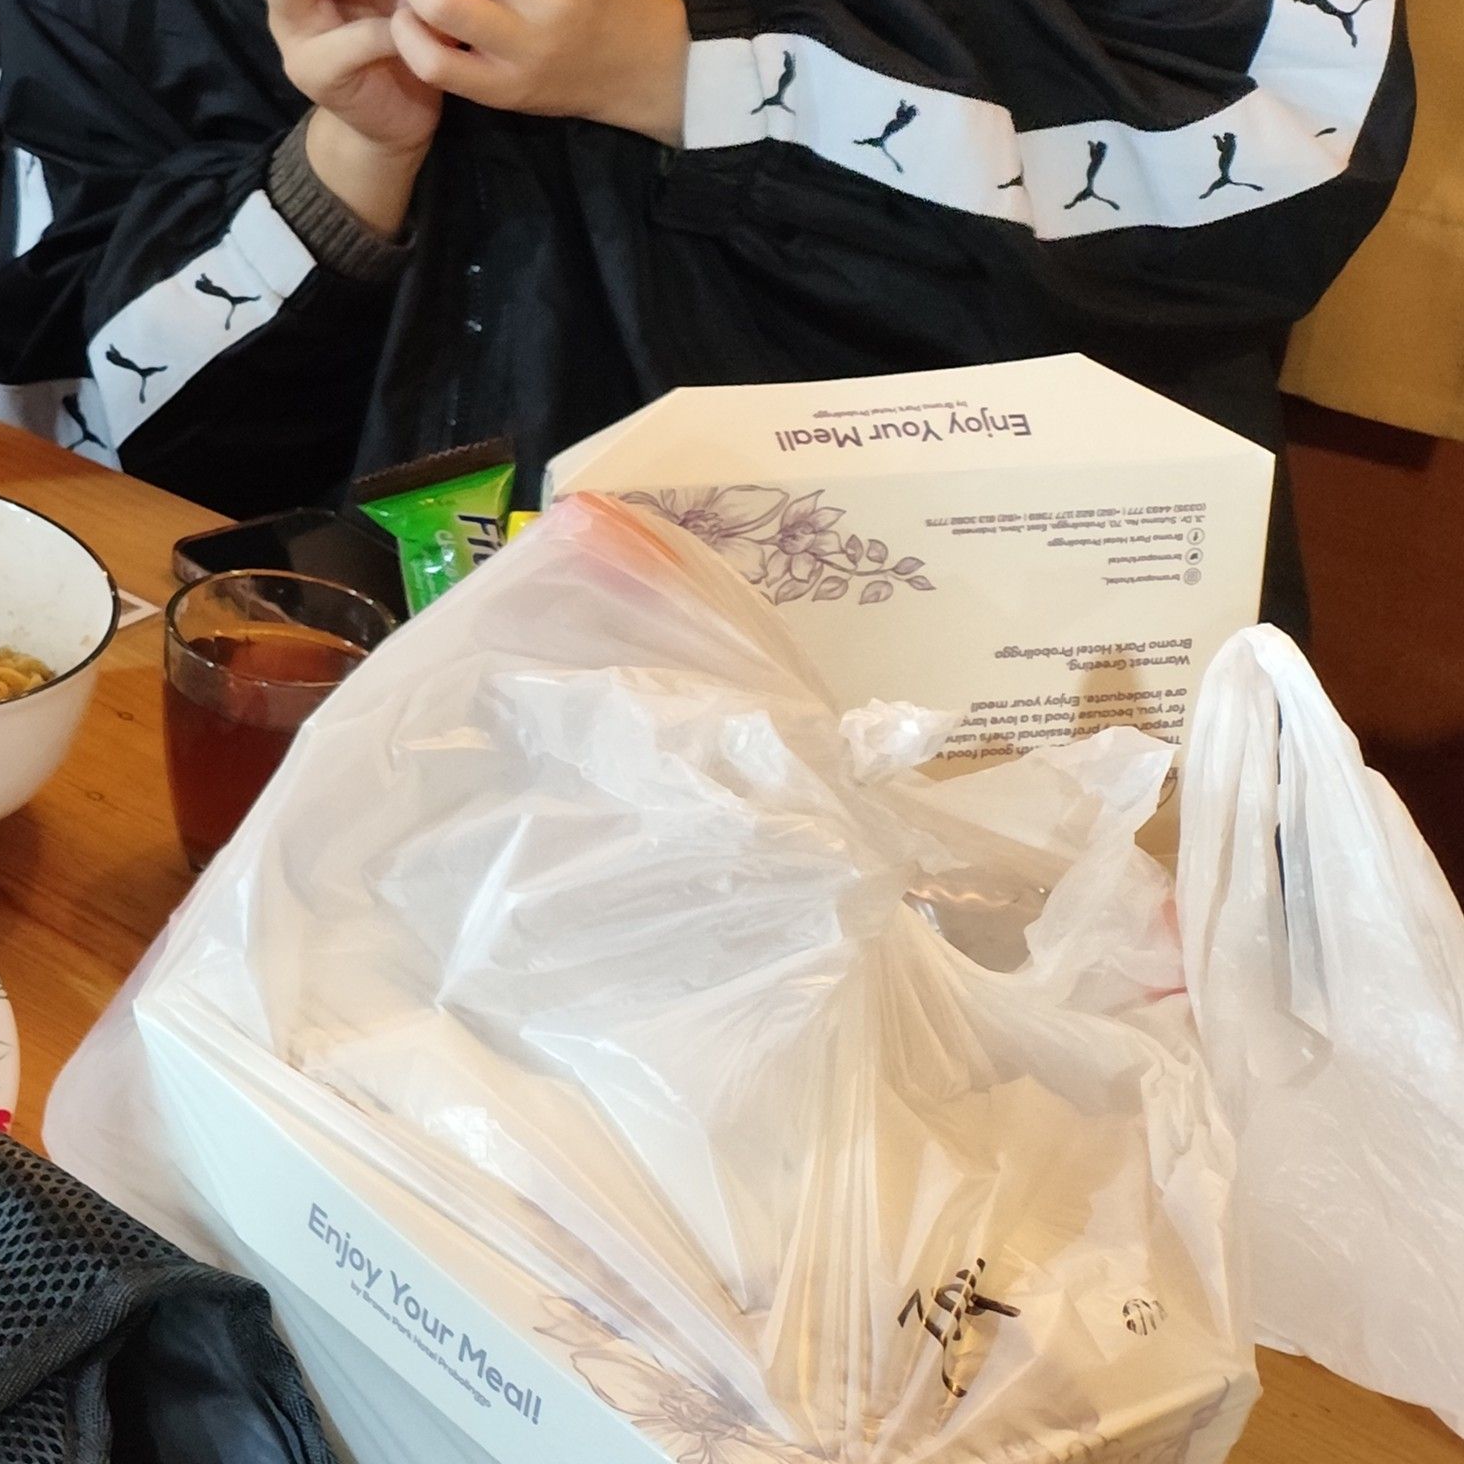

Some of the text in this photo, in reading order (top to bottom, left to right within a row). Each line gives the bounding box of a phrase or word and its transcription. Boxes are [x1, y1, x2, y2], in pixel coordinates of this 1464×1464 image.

[774, 406, 1032, 452] Enjoy Your Meal!
[994, 638, 1193, 660] Bromo Park Hotel Probolinggo
[1129, 654, 1191, 669] Warmest
[1164, 687, 1187, 698] are
[1010, 696, 1042, 709] your
[1044, 693, 1081, 708] Enjoy
[1078, 707, 1134, 721] because
[1166, 702, 1186, 715] for
[990, 715, 1018, 726] love
[1032, 714, 1042, 725] is
[1044, 712, 1076, 724] food
[979, 731, 1016, 744] chefs
[1017, 724, 1100, 742] professional
[947, 749, 978, 761] food
[980, 743, 1014, 759] good
[307, 1202, 542, 1425] Enjoy Your Meal!
